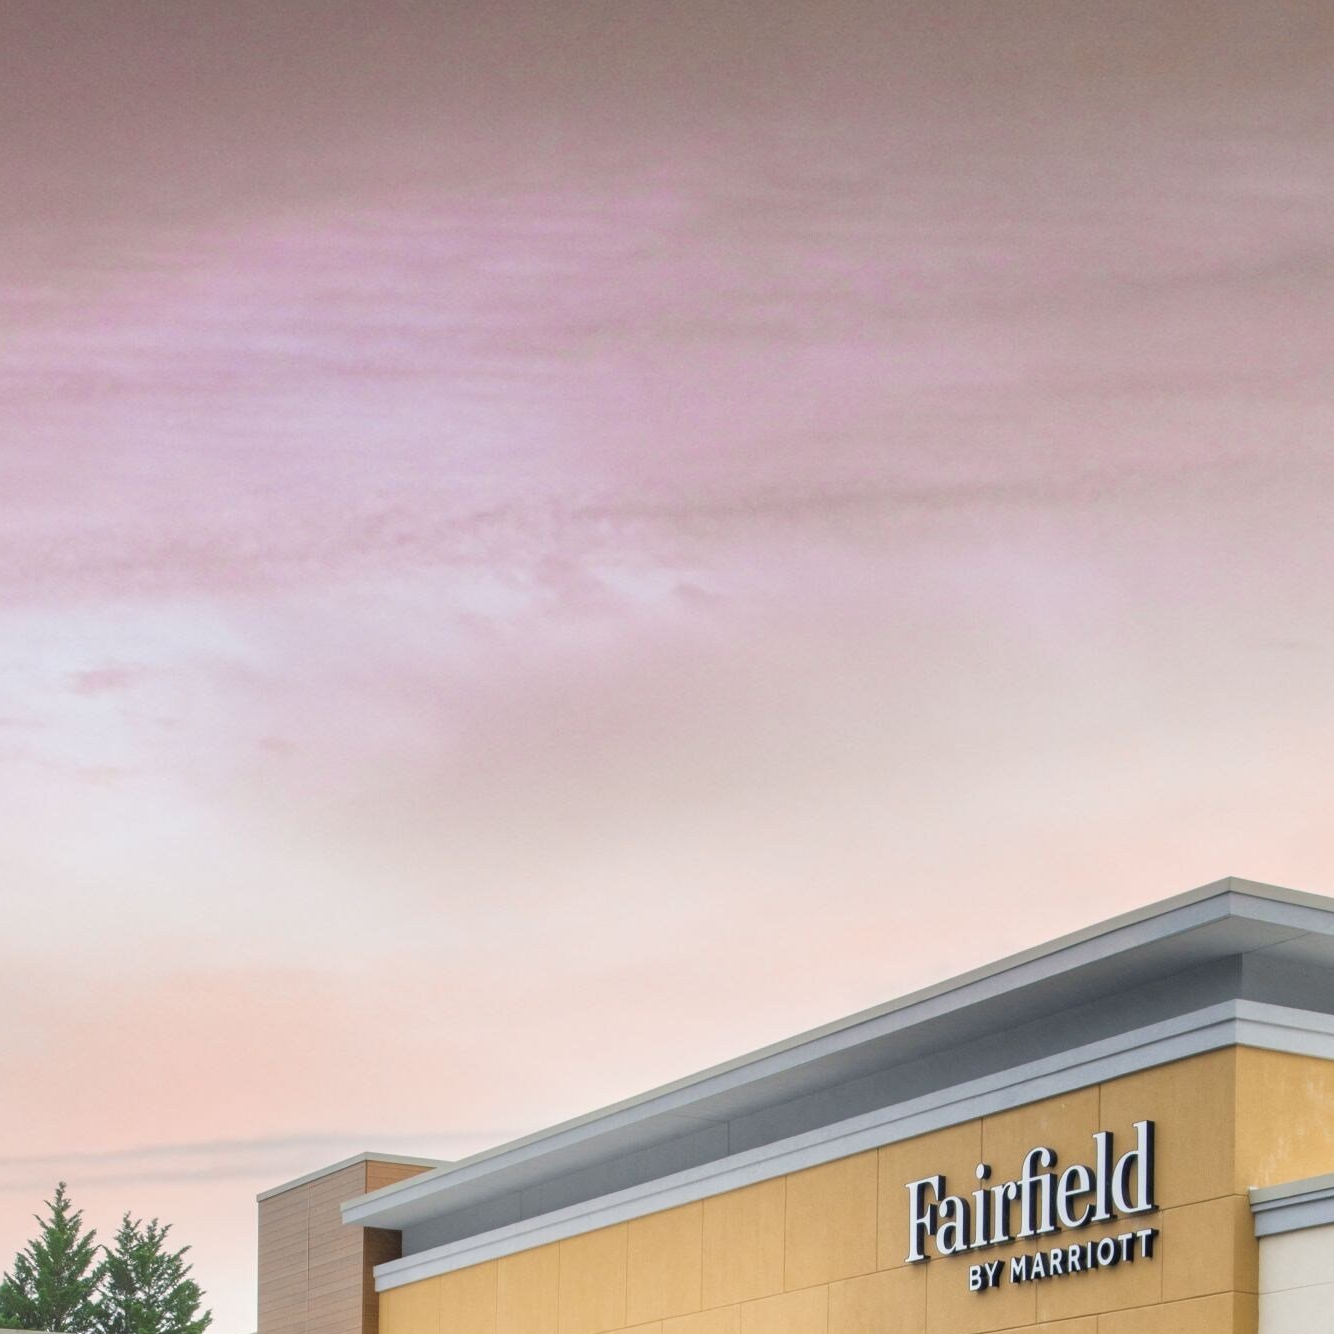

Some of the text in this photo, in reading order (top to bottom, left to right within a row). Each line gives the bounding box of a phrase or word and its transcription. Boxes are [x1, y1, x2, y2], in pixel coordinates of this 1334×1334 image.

[904, 1119, 1159, 1265] Fairfield
[969, 1228, 1159, 1295] BY MARRIOTT
